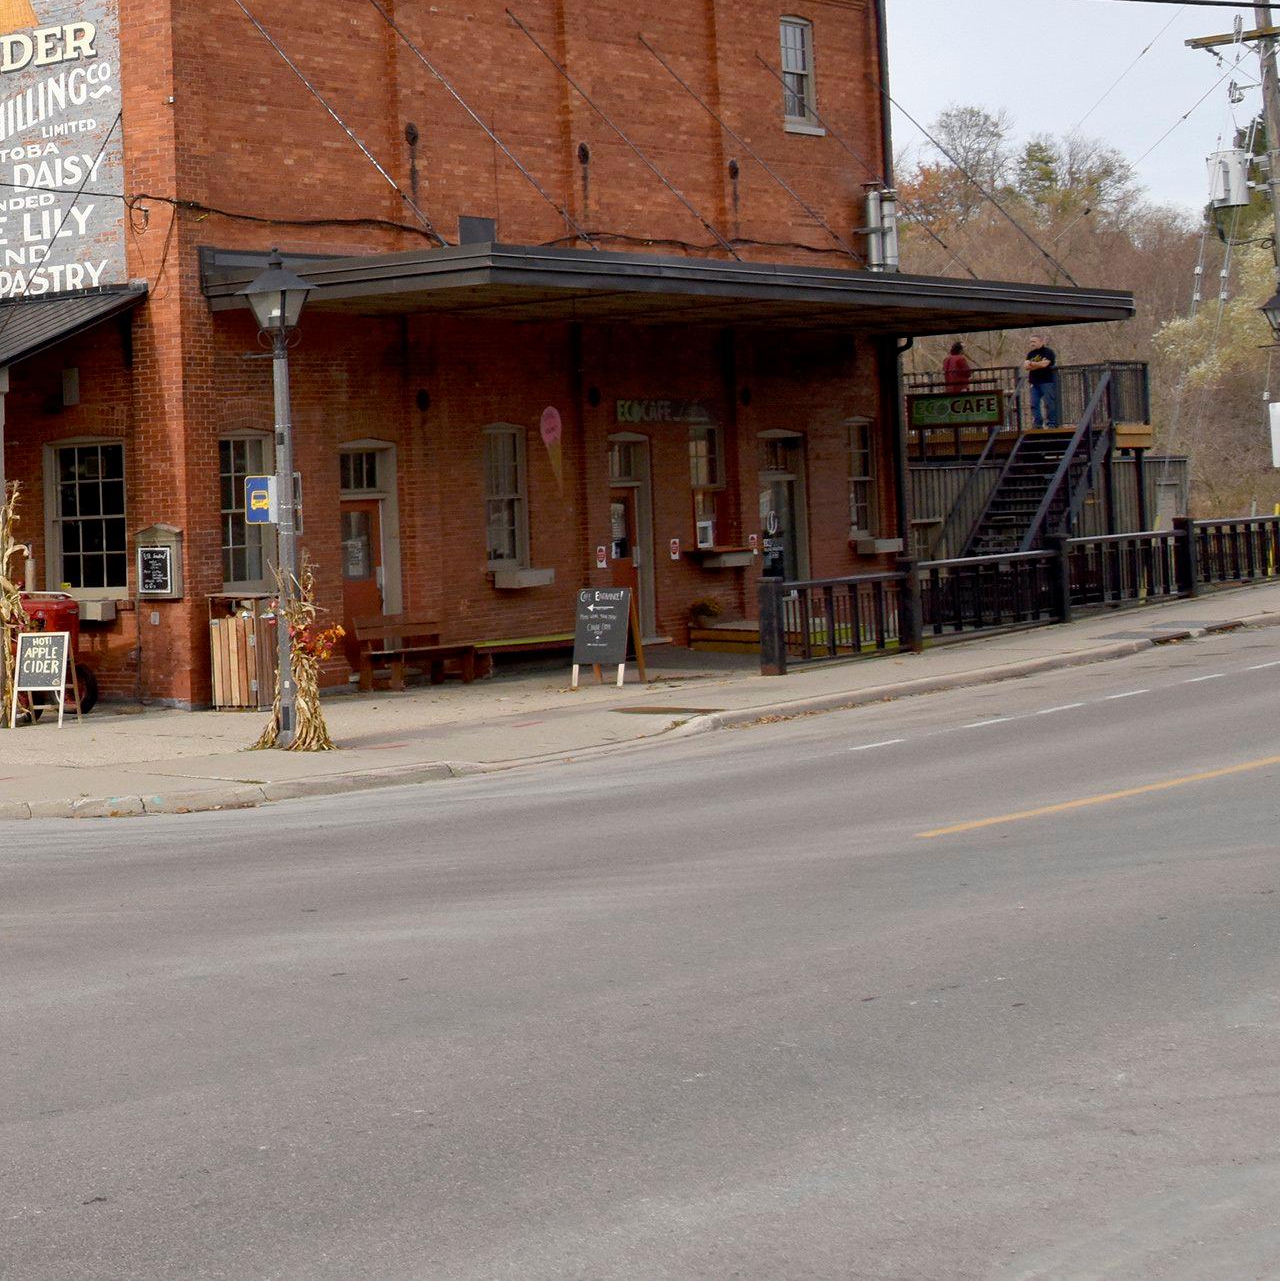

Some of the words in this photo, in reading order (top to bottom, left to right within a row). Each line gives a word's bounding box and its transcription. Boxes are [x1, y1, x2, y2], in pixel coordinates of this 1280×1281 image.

[42, 117, 97, 139] LIMITED
[13, 152, 106, 194] DAISY
[23, 204, 96, 242] LILY
[32, 636, 52, 646] HOT!
[24, 647, 58, 659] APPLE
[23, 659, 59, 674] CIDER
